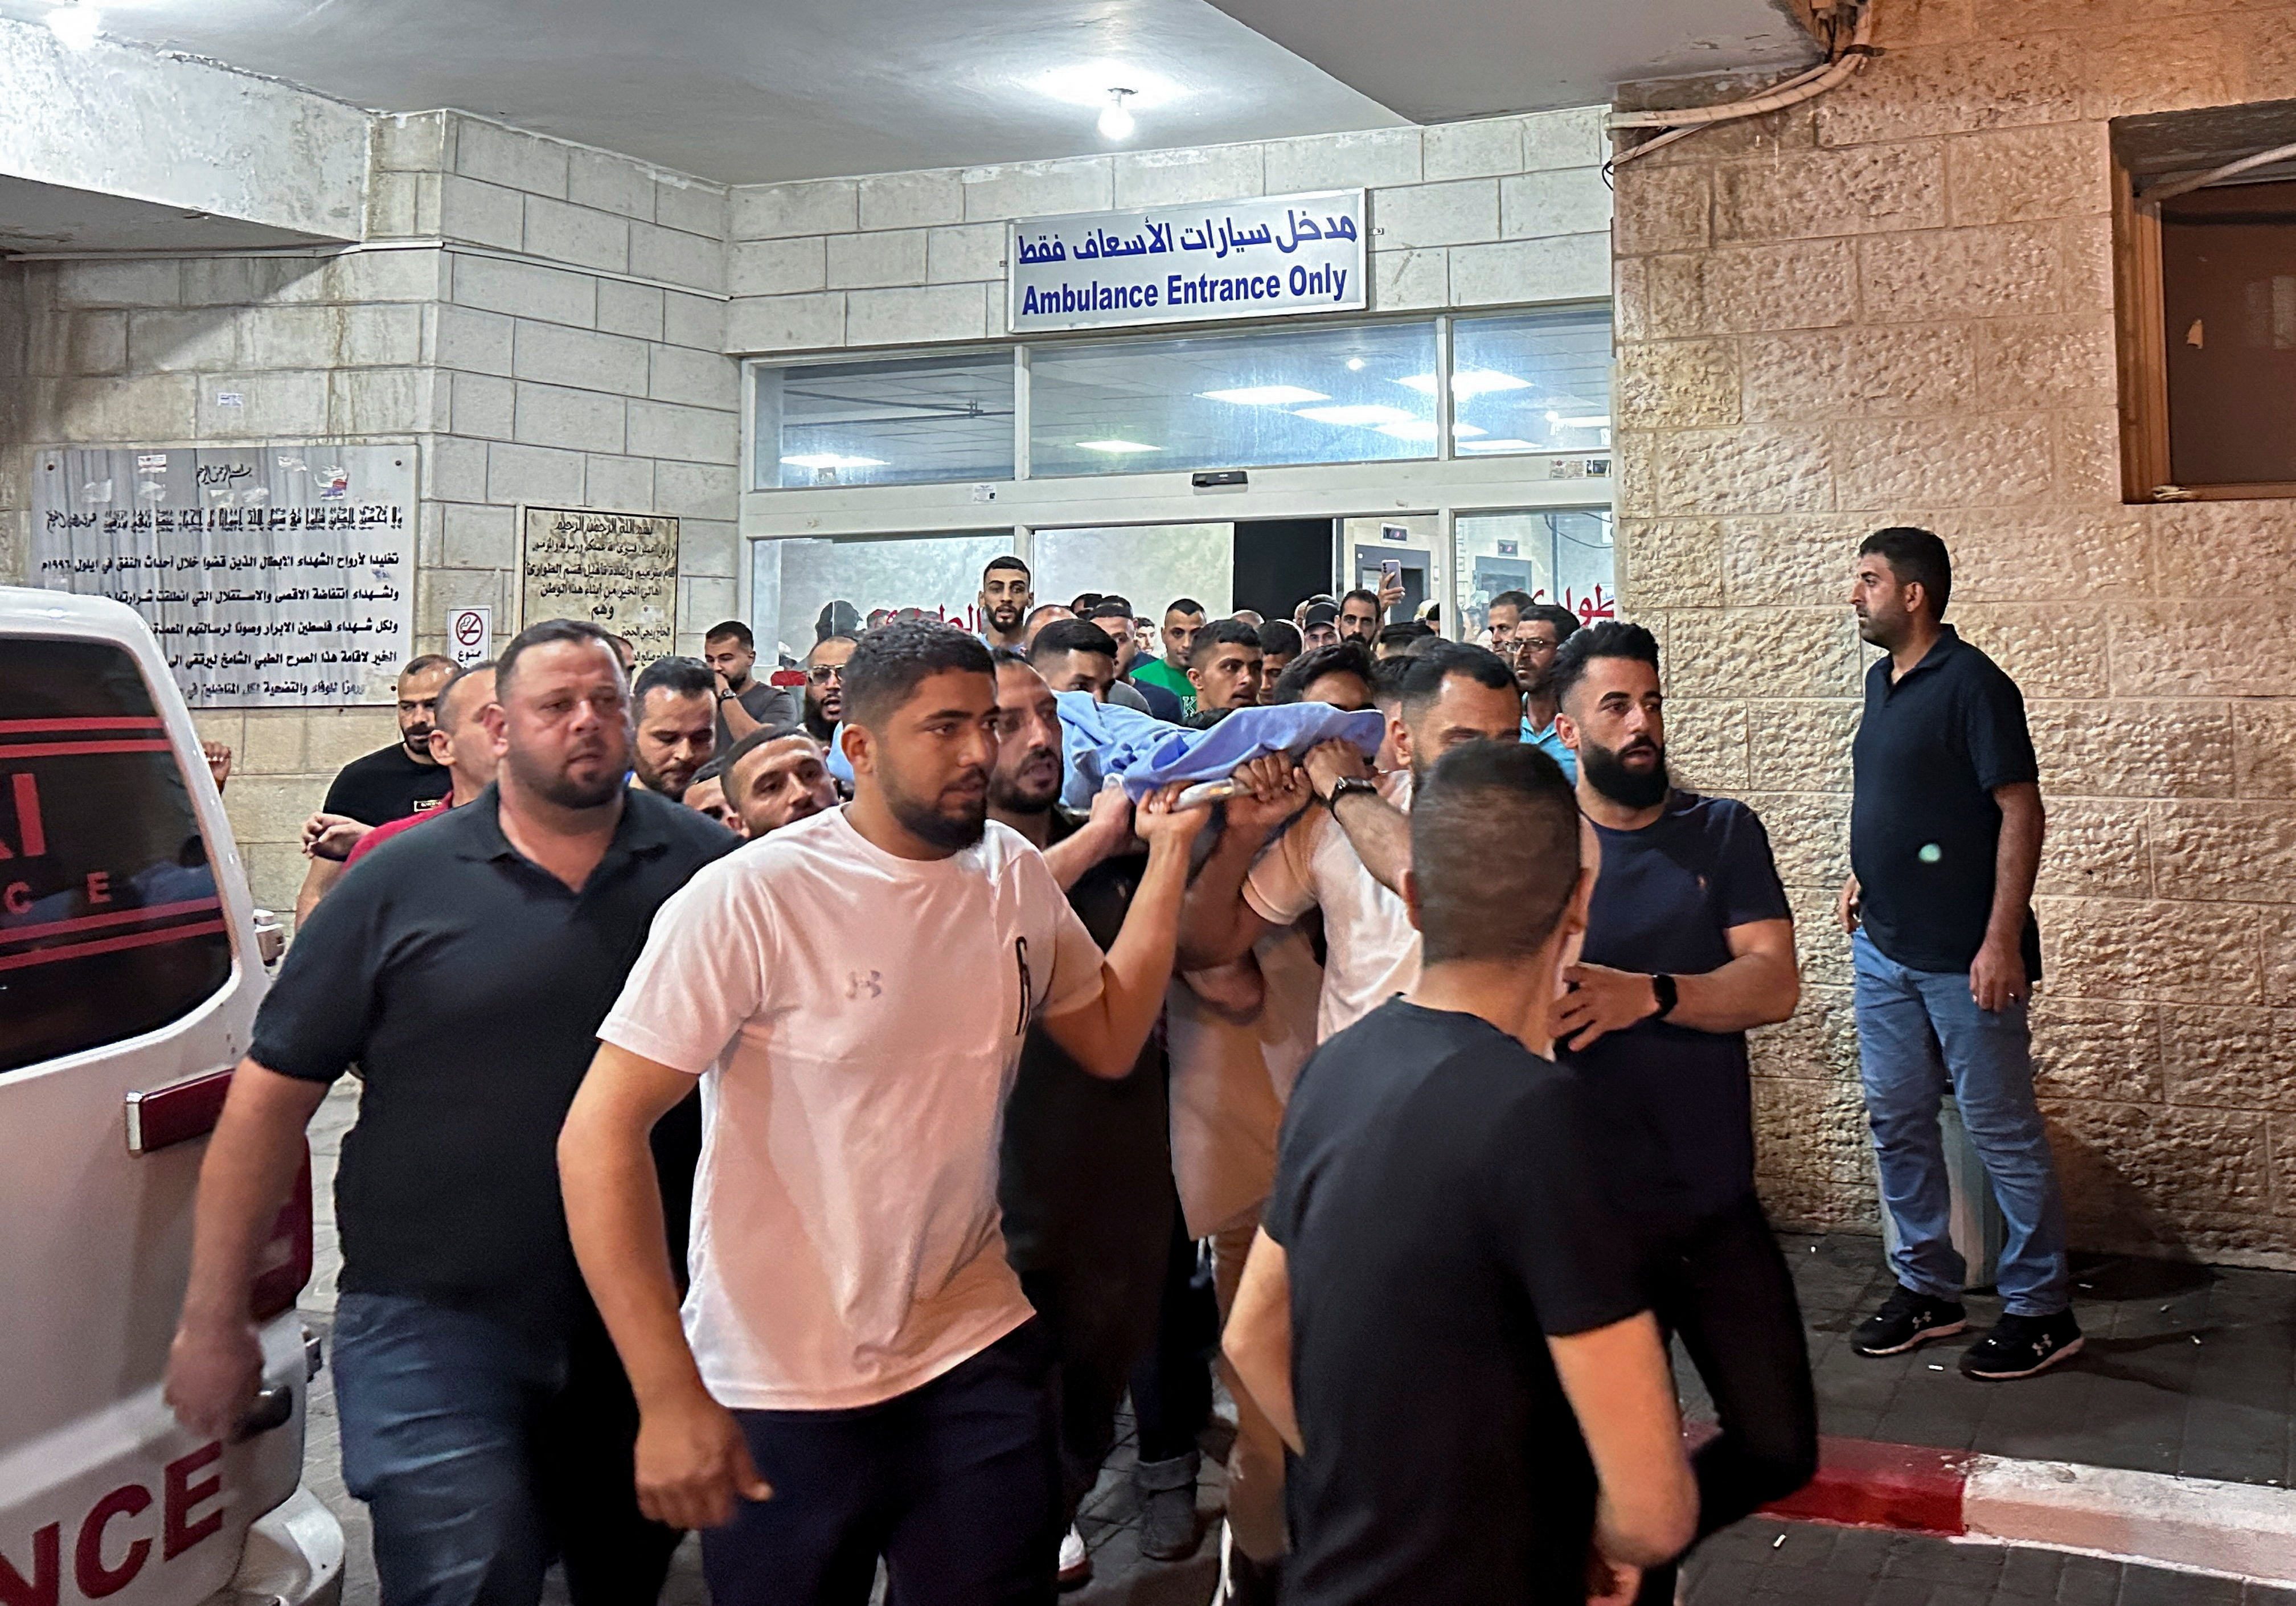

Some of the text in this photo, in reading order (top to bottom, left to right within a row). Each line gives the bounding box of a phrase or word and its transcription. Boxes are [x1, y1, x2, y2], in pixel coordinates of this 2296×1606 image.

[1018, 210, 1358, 264] مدخل سيارات الأسعاف فقط
[1022, 263, 1347, 316] Ambulance Entrance Only
[101, 556, 113, 574] في
[176, 555, 199, 571] خلال
[229, 555, 256, 571] الذين
[297, 551, 334, 569] الشهداء
[191, 589, 212, 607] التي
[591, 601, 614, 621] وهم
[298, 620, 332, 636] فلسطين
[375, 619, 398, 634] ولكل
[286, 653, 317, 667] الصرح
[321, 650, 338, 663] هذا
[371, 649, 397, 666] الخير
